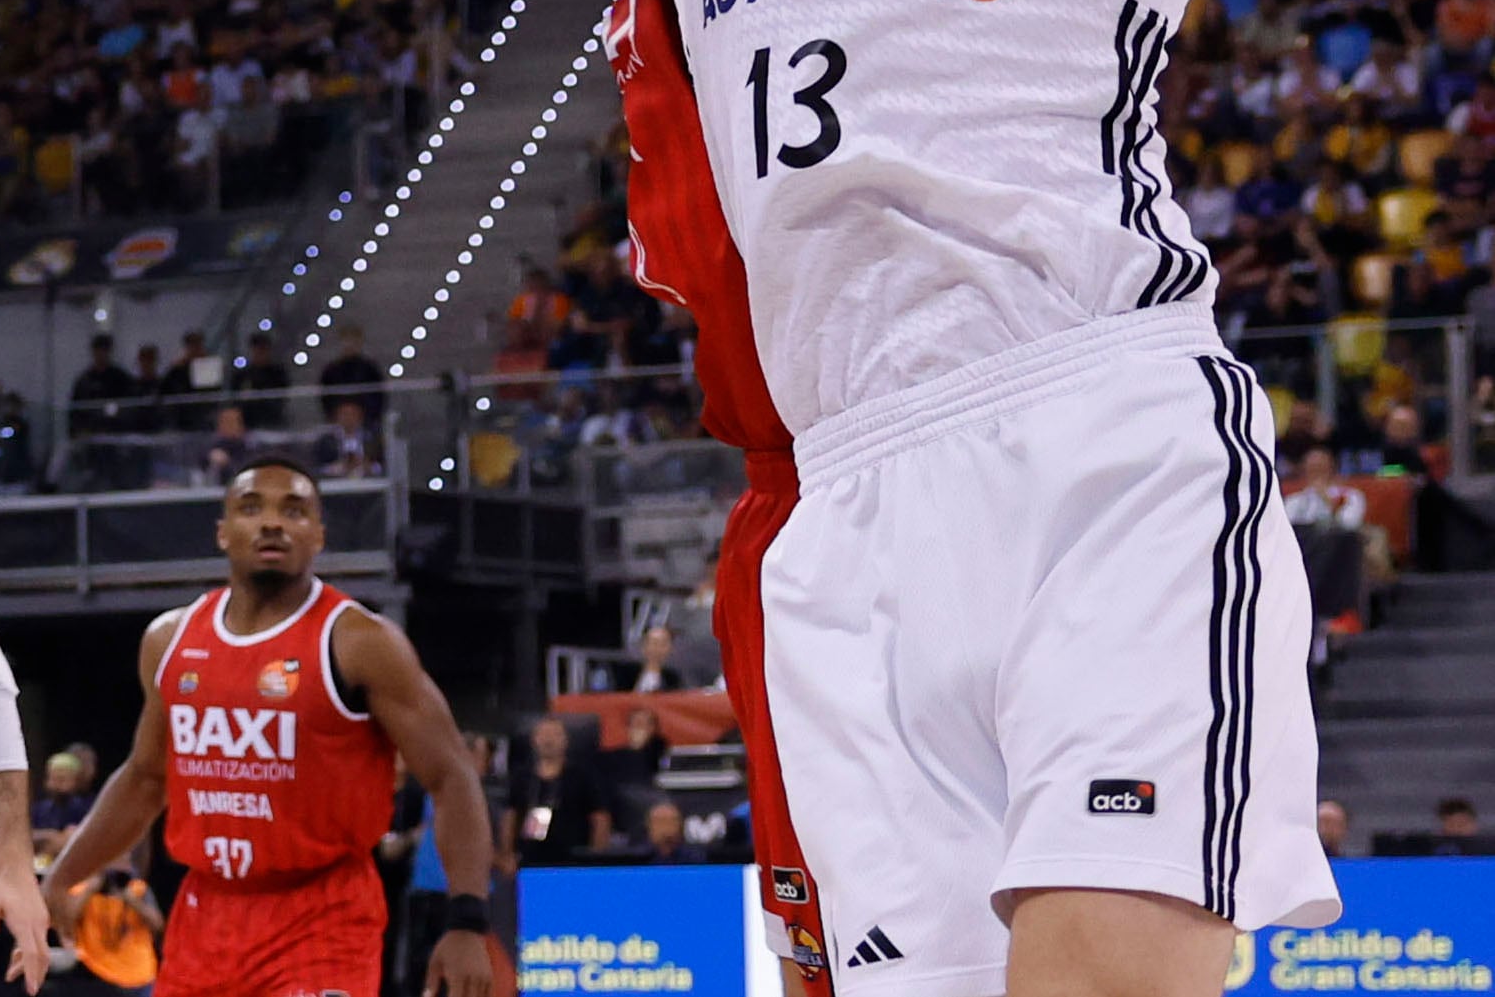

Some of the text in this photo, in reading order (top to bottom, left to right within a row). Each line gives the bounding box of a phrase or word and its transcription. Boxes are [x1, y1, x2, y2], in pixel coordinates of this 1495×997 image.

[745, 38, 847, 179] 13
[170, 704, 297, 760] BAXI
[1092, 791, 1142, 811] acb
[774, 881, 798, 898] acb
[520, 934, 660, 964] abildo de
[1268, 929, 1454, 961] Cabildo de
[517, 961, 694, 992] ran Canaria
[1269, 957, 1493, 991] Gran Canaria
